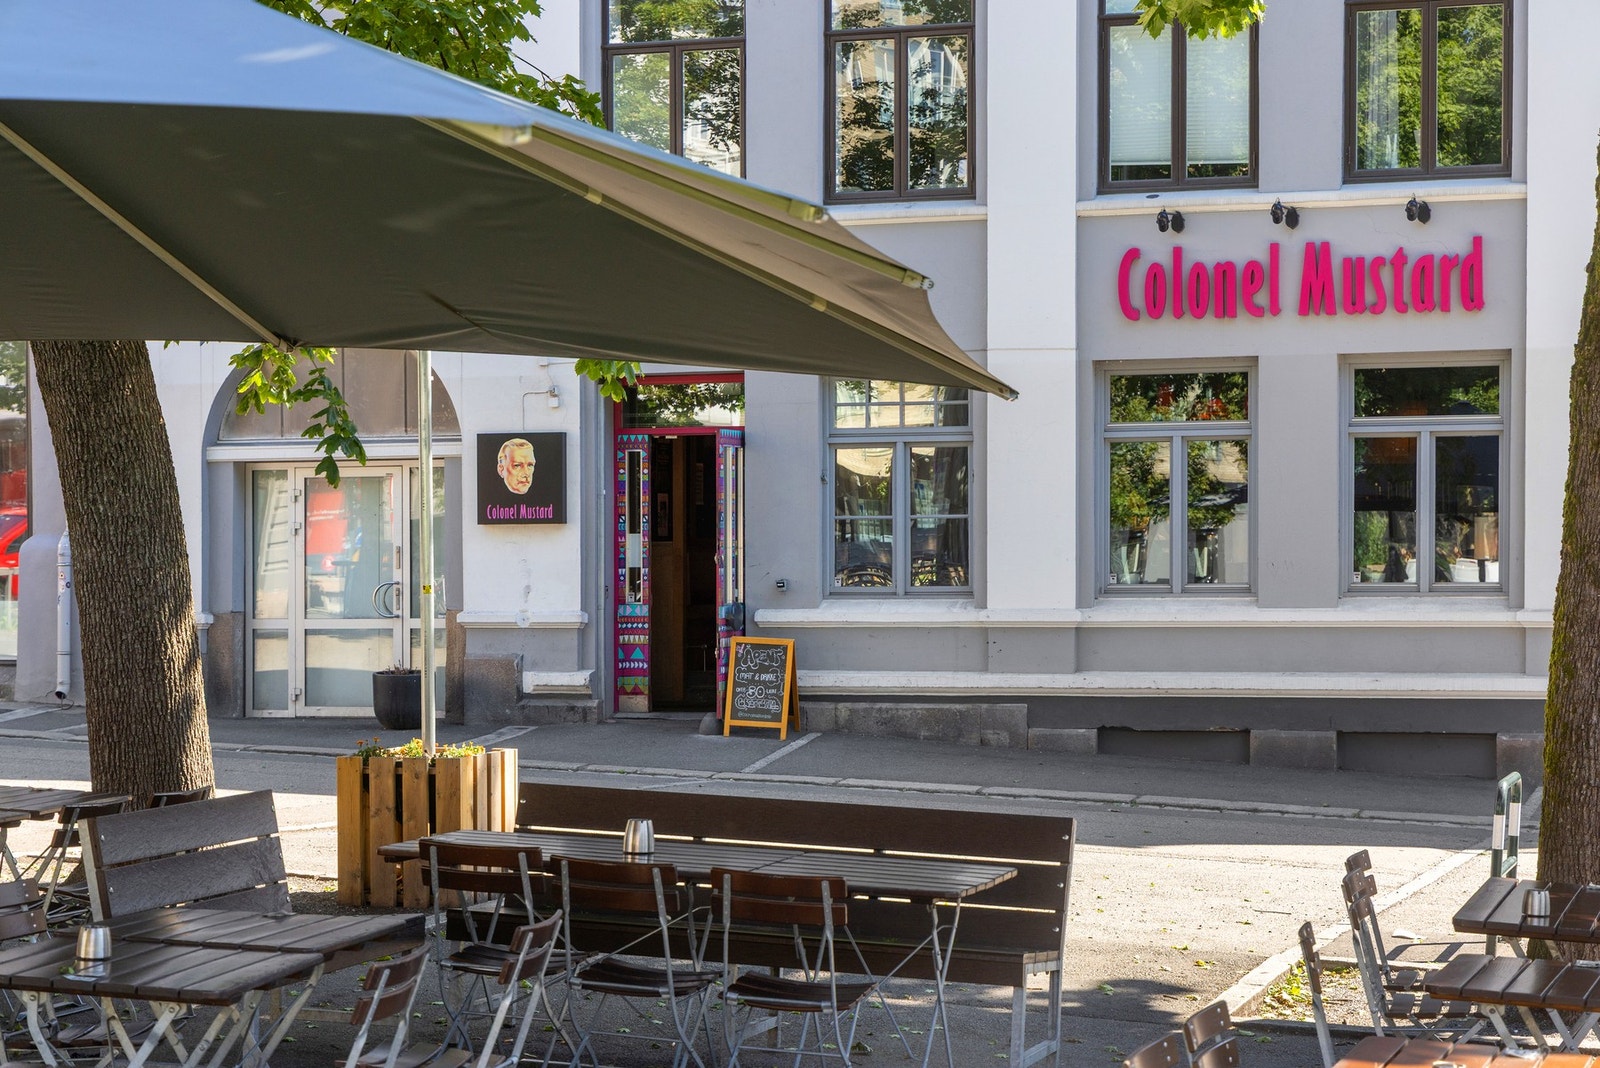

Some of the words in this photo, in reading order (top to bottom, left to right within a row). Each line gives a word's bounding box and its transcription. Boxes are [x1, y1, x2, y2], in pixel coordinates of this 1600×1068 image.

[1118, 242, 1281, 321] Colonel
[1298, 235, 1485, 316] Mustard
[486, 503, 517, 519] Colonel
[519, 503, 553, 519] Mustard
